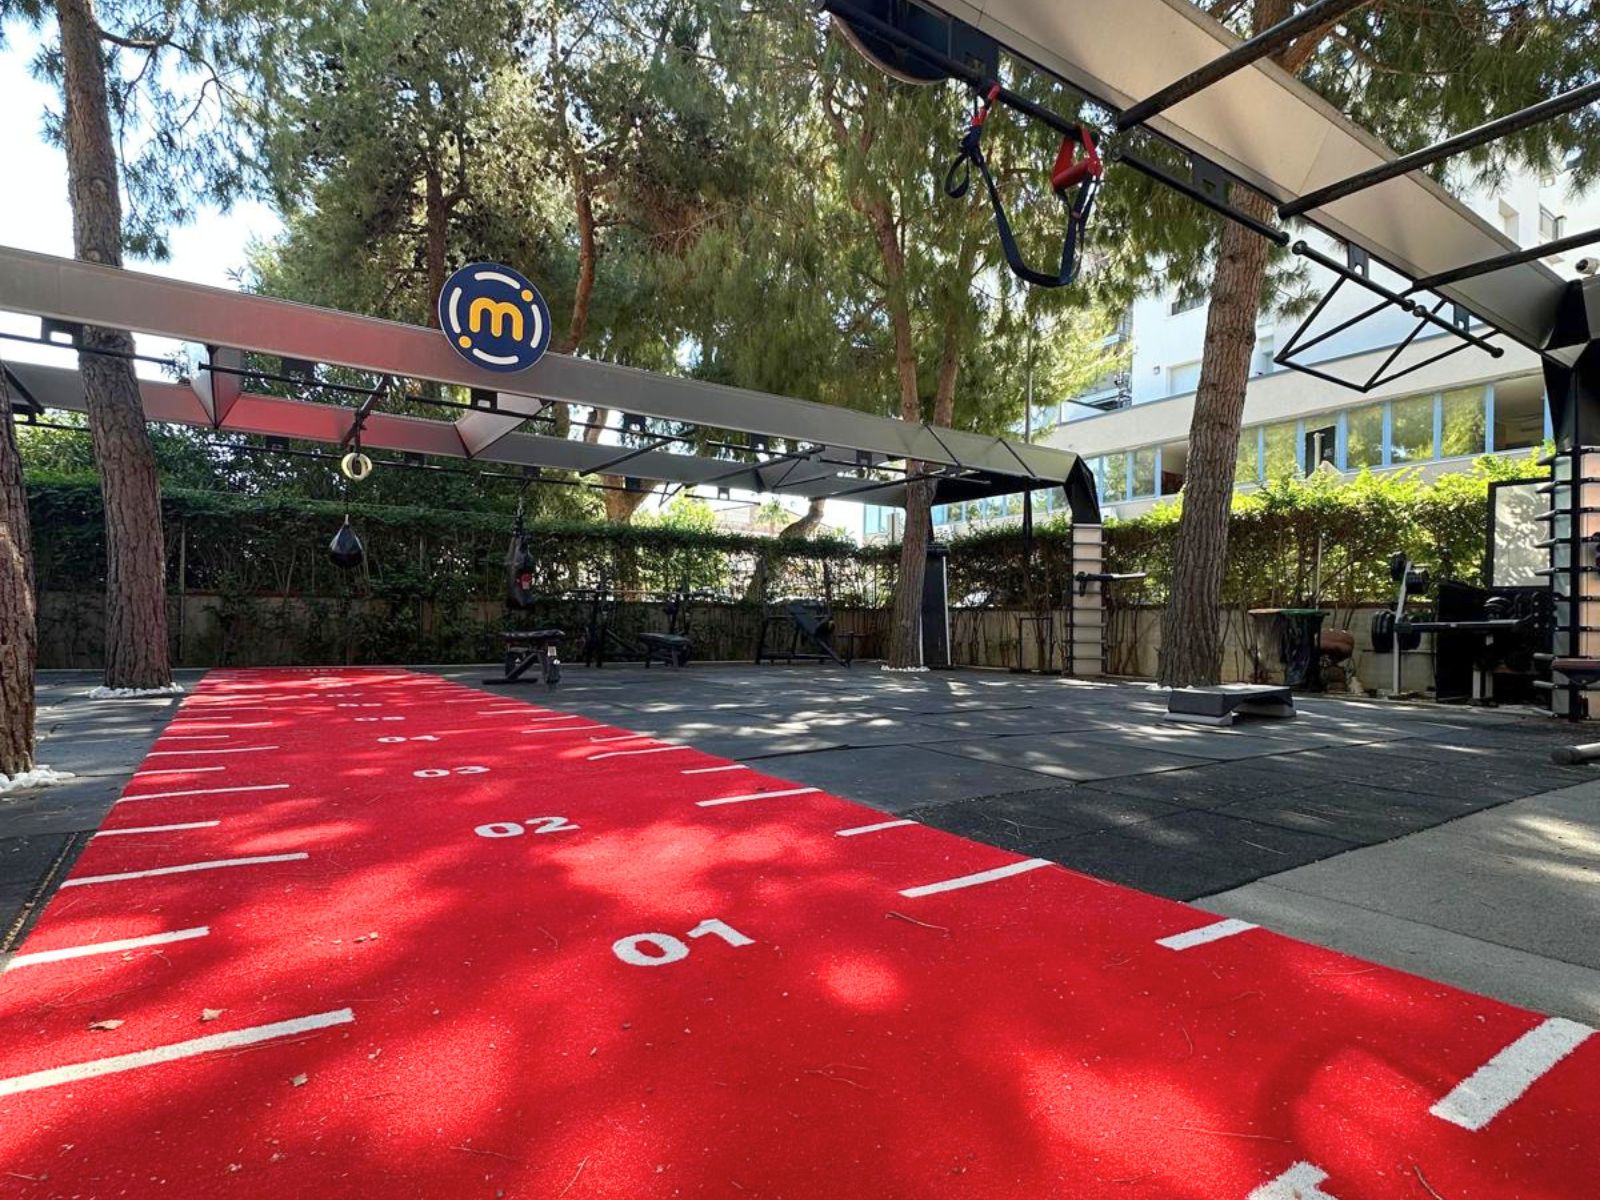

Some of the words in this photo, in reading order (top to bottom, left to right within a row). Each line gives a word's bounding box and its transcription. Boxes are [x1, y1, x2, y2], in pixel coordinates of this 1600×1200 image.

[469, 297, 524, 341] m
[412, 765, 491, 779] 03
[473, 815, 581, 839] 02
[611, 917, 756, 967] 01
